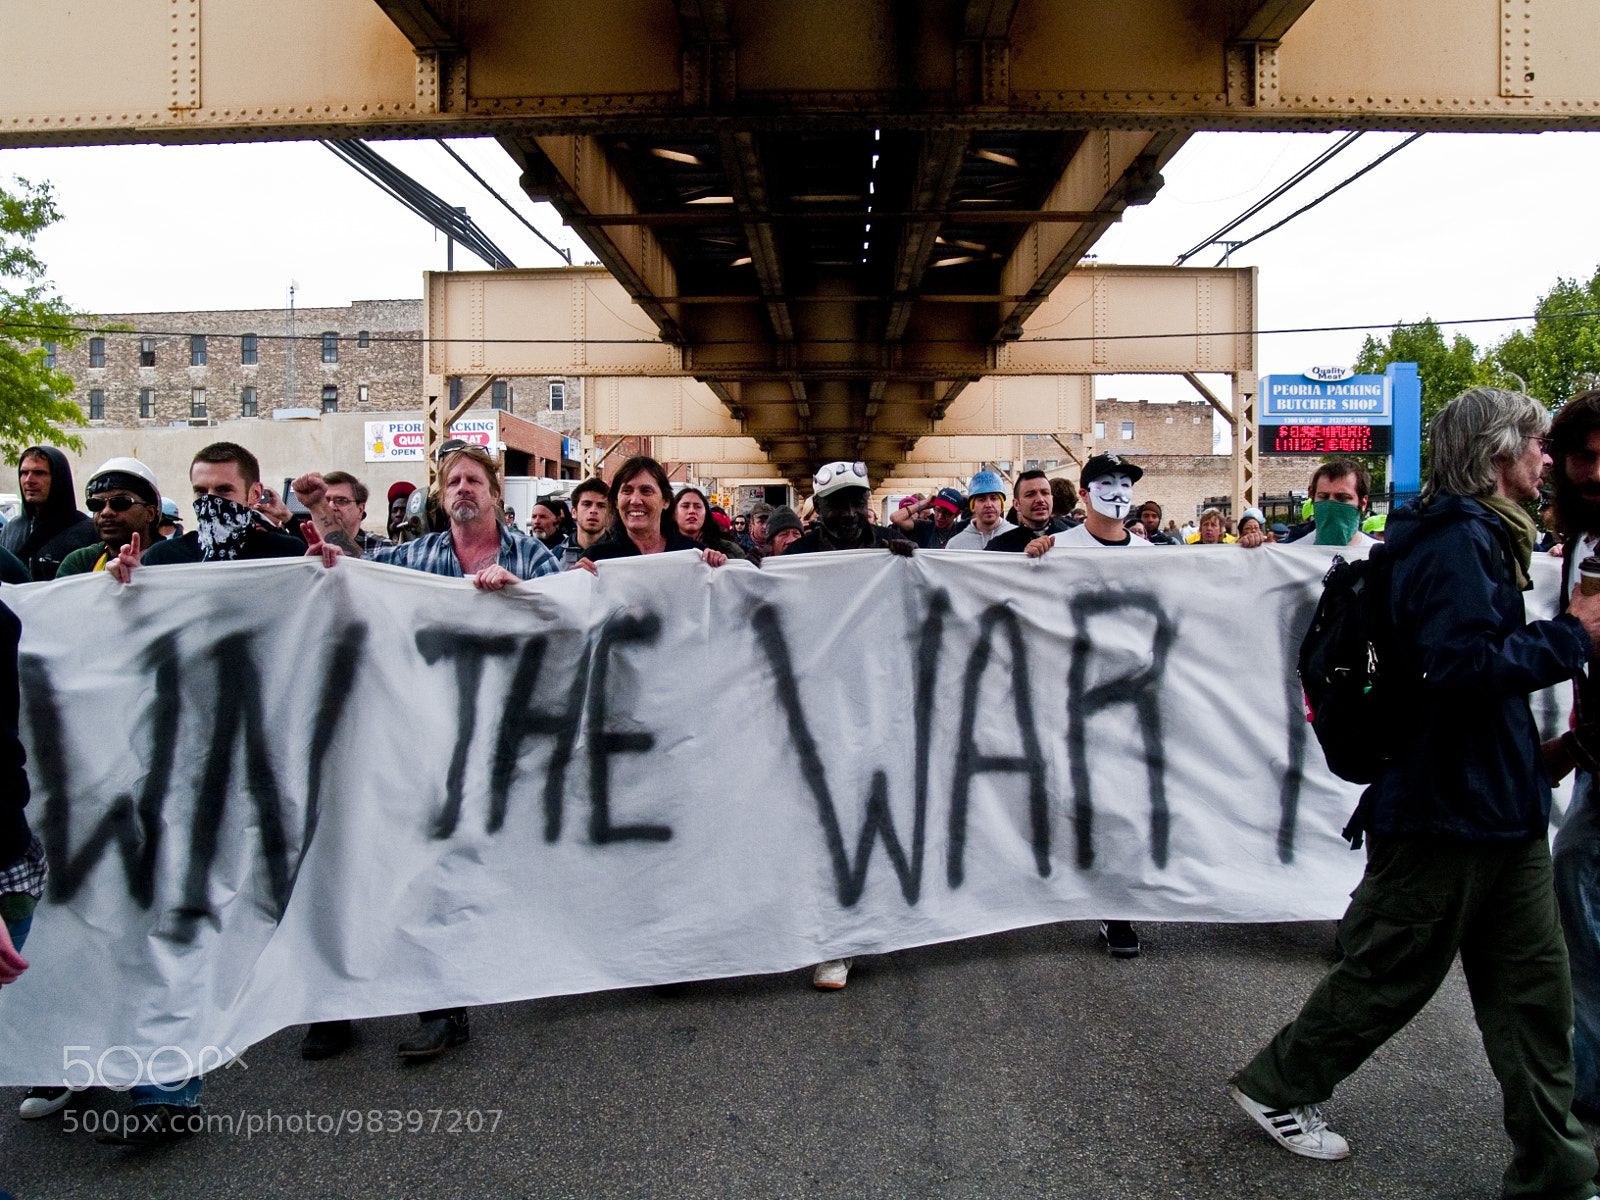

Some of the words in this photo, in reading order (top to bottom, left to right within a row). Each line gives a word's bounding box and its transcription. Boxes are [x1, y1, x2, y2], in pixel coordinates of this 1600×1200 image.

[1312, 366, 1345, 375] Quality
[1273, 384, 1321, 396] PEORIA
[1326, 384, 1381, 396] PACKING
[1276, 398, 1336, 410] BUTCHER
[1341, 398, 1378, 410] SHOP
[450, 421, 494, 431] ACKING
[391, 448, 416, 456] OPEN
[414, 606, 673, 846] THE
[751, 586, 1177, 906] WAR
